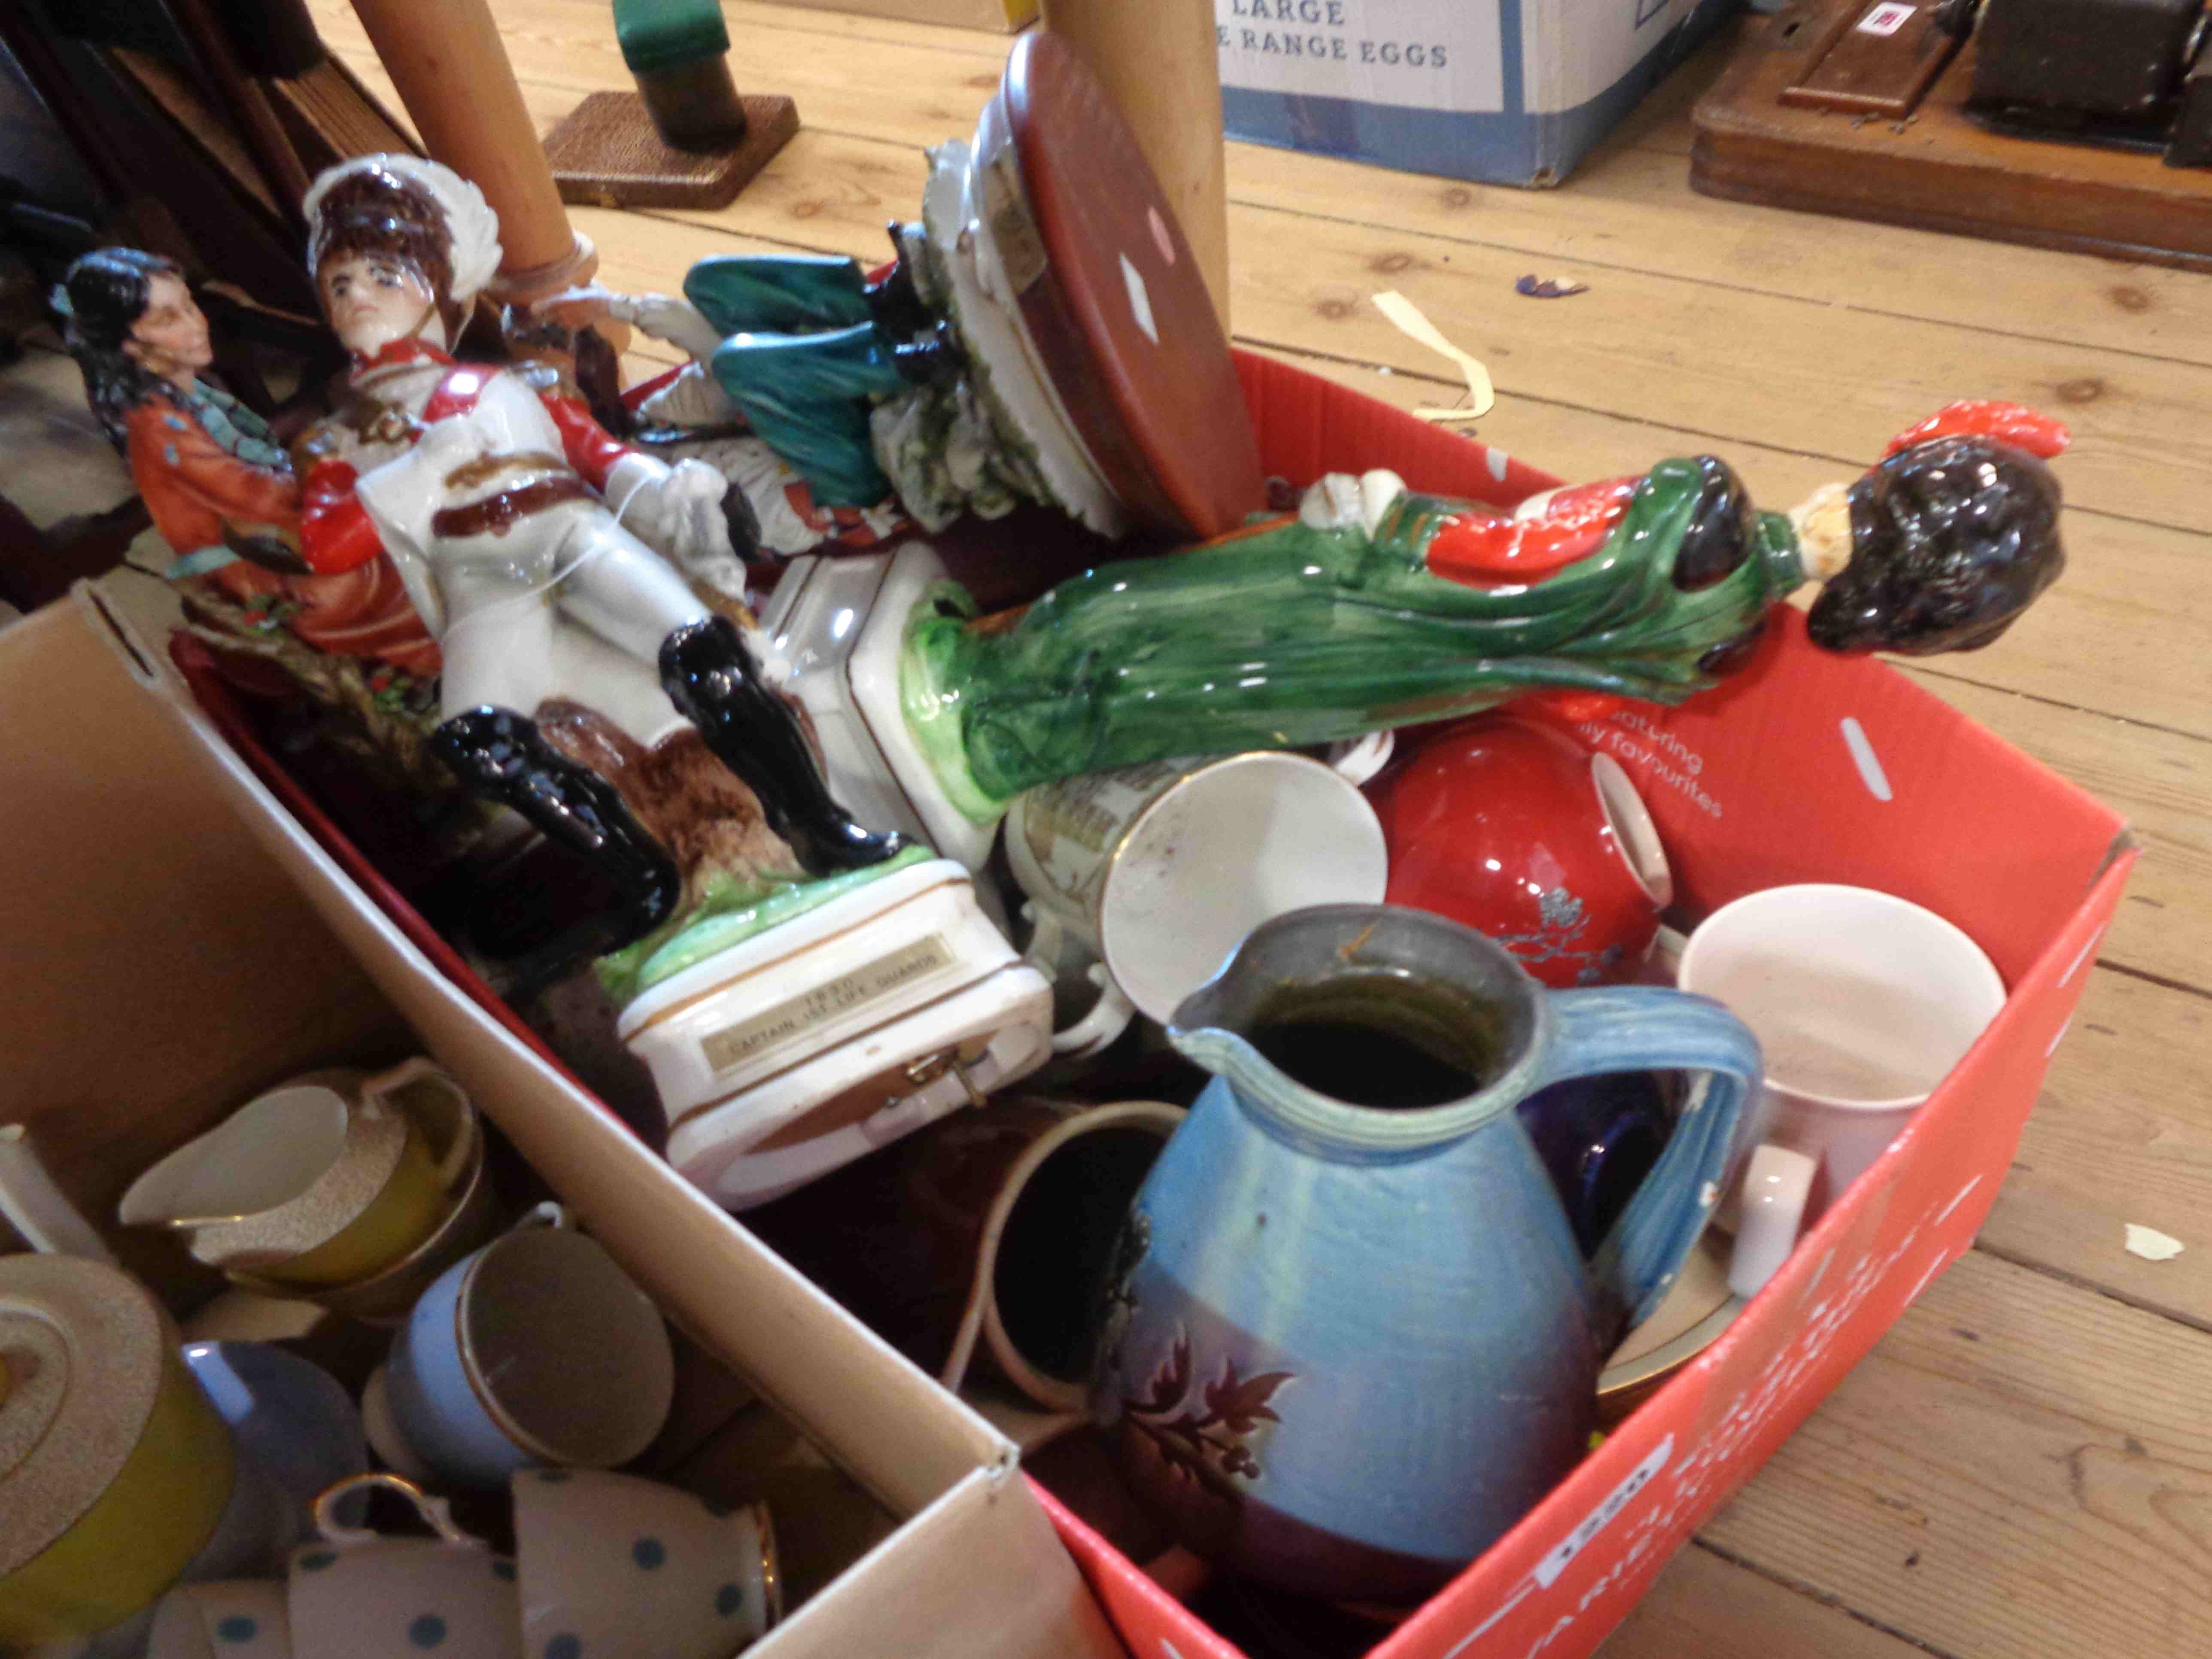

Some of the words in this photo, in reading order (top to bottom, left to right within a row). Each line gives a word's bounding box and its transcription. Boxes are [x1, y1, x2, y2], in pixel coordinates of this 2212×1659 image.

[1233, 0, 1345, 25] LARGE
[1241, 28, 1347, 60] RANGE
[1360, 40, 1448, 68] EGGS
[1611, 730, 1722, 818] favourites
[730, 1019, 795, 1053] CAPTAIN
[877, 955, 938, 987] GUARDS
